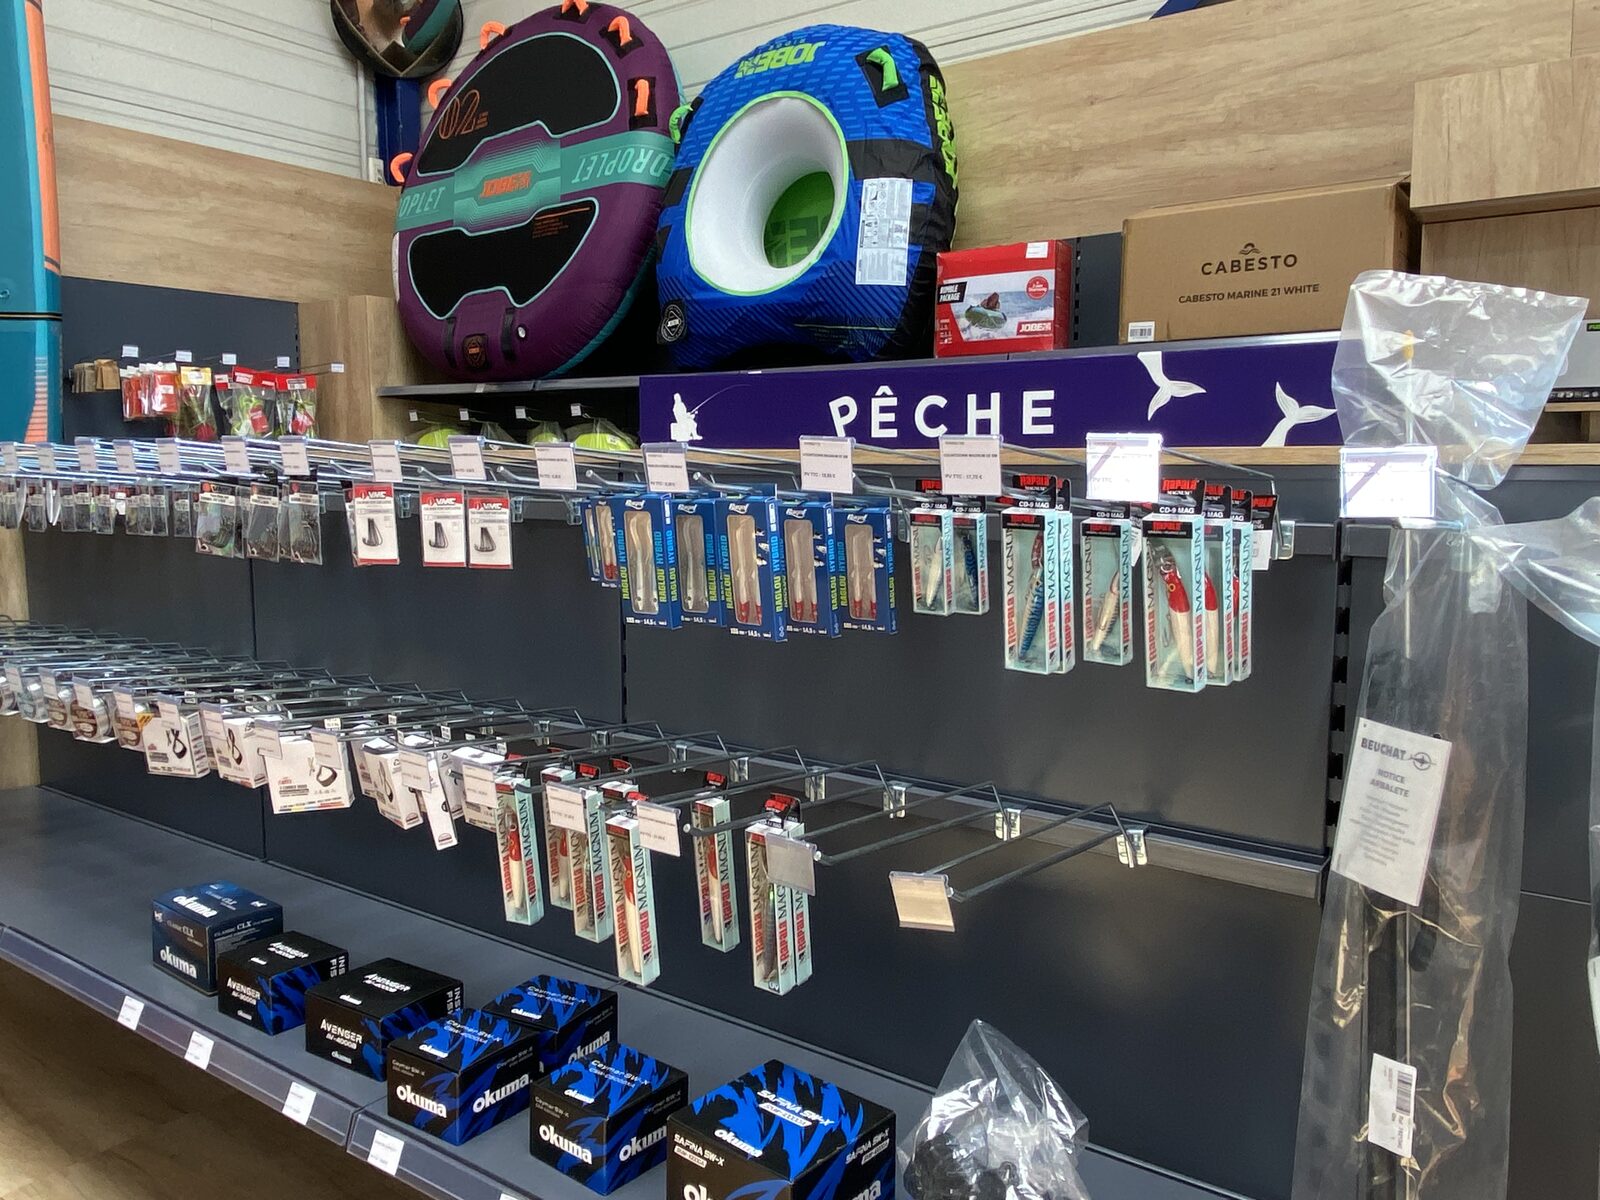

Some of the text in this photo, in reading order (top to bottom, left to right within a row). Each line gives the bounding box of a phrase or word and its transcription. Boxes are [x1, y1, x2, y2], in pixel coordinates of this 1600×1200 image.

[752, 41, 826, 77] JOBE
[571, 147, 670, 184] DROPLET
[1200, 253, 1299, 276] CABESTO
[1178, 283, 1321, 304] CABESTO MARINE 21 WHITE
[828, 385, 1056, 438] PÊCHE
[367, 490, 387, 499] VMC
[435, 497, 456, 506] VMC
[482, 502, 503, 511] VMC
[1034, 501, 1050, 509] MAG
[1159, 506, 1195, 514] CD-9 MAG
[653, 530, 664, 565] HYBRID
[665, 529, 676, 564] HYBRID
[770, 535, 780, 573] HYBRID
[827, 538, 836, 573] HYBRID
[1005, 528, 1015, 595] MAGNU
[1047, 520, 1056, 600] MAGNUM
[1193, 525, 1202, 612] MAGNUM
[1224, 528, 1232, 611] MAGNUM
[1240, 534, 1250, 610] MAGNUM
[773, 575, 784, 613] RAGLOU
[1360, 737, 1407, 760] BEUCHAT
[1369, 778, 1410, 798] ARBALETE
[1377, 768, 1406, 784] NOTICE
[519, 798, 533, 857] MAGNUM
[589, 811, 602, 873] MAGNUM
[632, 843, 648, 911] MAGNUM
[172, 895, 218, 918] okuma
[777, 884, 788, 920] MAG
[236, 920, 253, 931] CLX
[159, 945, 198, 979] okuma
[226, 977, 261, 1000] AVENGER
[510, 1007, 542, 1020] okuma
[320, 1018, 363, 1044] AVENGER
[567, 1030, 611, 1063] okuma
[418, 1043, 449, 1059] okuma
[396, 1085, 447, 1118] okuma
[472, 1073, 531, 1113] okuma
[563, 1088, 595, 1104] okuma
[756, 1089, 802, 1114] SAFINA
[798, 1108, 836, 1127] SW-X
[538, 1124, 593, 1165] okuma
[619, 1125, 667, 1162] okum
[673, 1133, 704, 1155] SAFINA
[703, 1150, 726, 1167] SW-X
[714, 1129, 763, 1158] okuma
[845, 1140, 872, 1165] SAFINA
